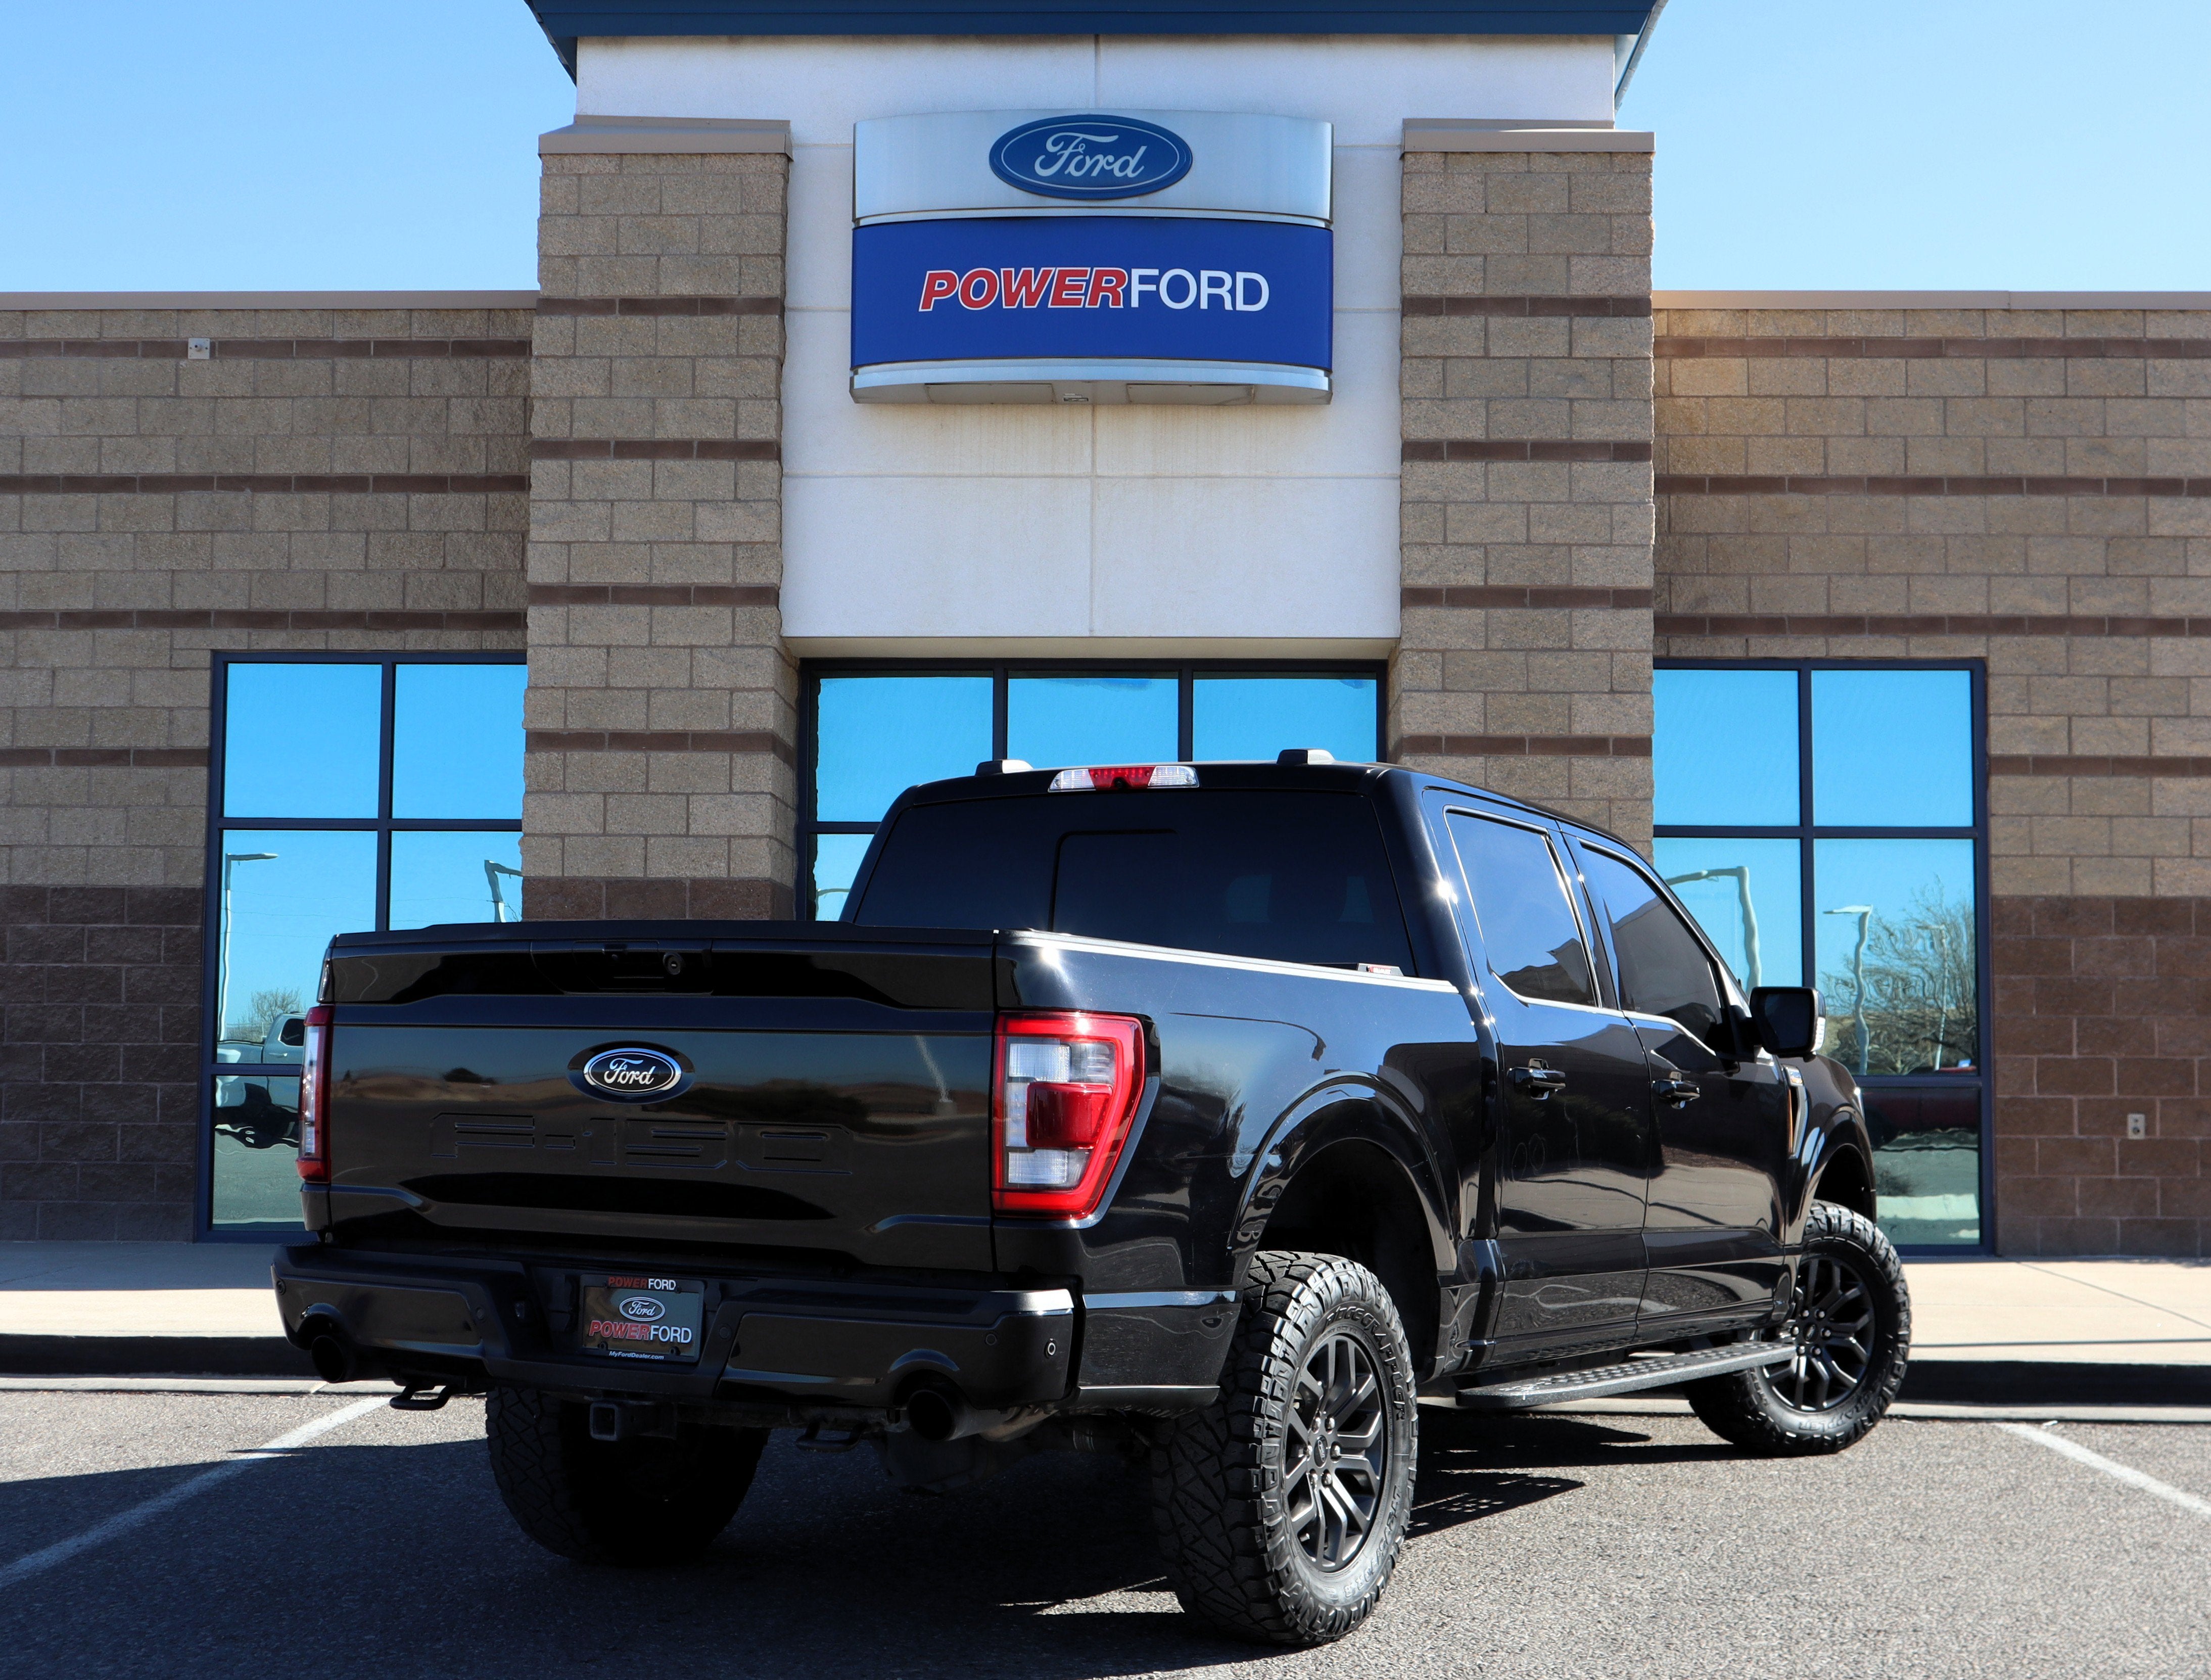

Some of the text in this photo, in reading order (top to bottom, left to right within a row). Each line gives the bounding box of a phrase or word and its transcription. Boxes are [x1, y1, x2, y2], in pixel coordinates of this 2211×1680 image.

[1034, 132, 1148, 178] Ford
[603, 1057, 656, 1085] Ford
[430, 1113, 853, 1175] F-150
[628, 1300, 656, 1317] Ford
[608, 1350, 665, 1360] MyFordDealer.com
